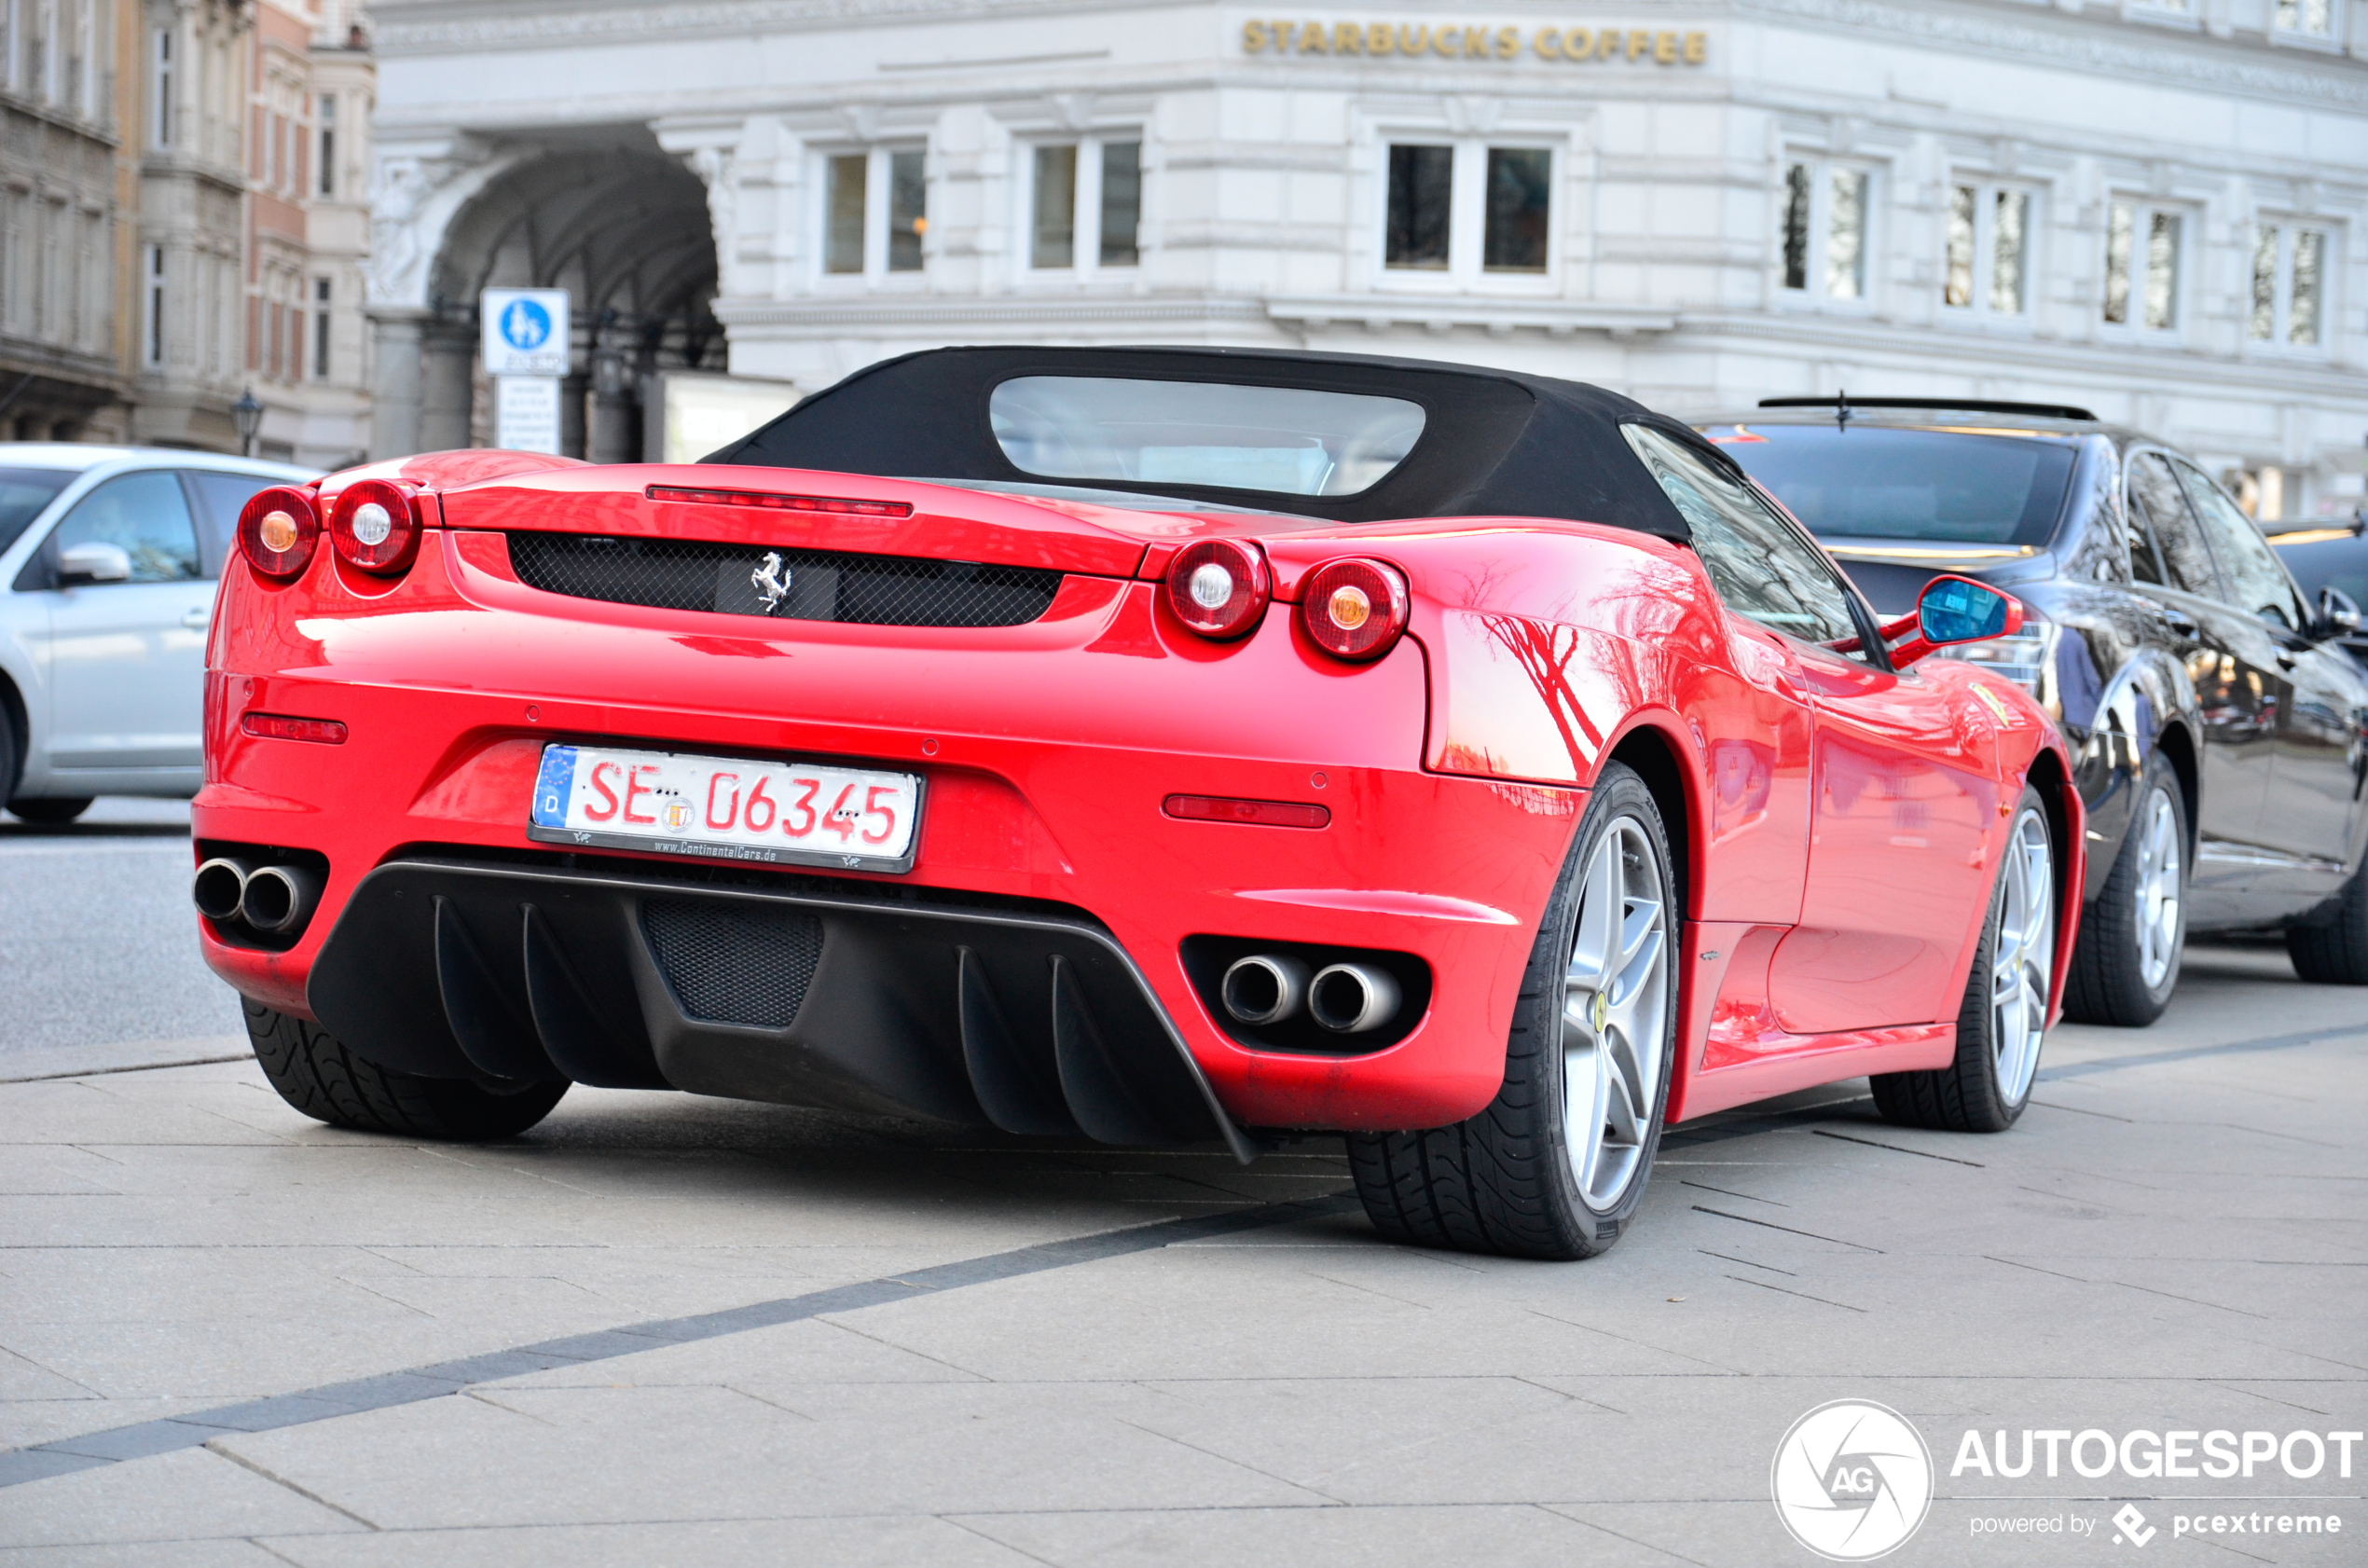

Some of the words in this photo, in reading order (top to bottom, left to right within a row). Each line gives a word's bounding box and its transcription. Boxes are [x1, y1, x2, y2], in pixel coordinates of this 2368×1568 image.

[1243, 19, 1521, 60] STARBUCKS
[1533, 26, 1708, 65] COFFEE
[544, 795, 558, 814] D
[584, 762, 658, 825] SE
[705, 772, 901, 846] 06345
[654, 841, 777, 861] www.ContinentalCars.de
